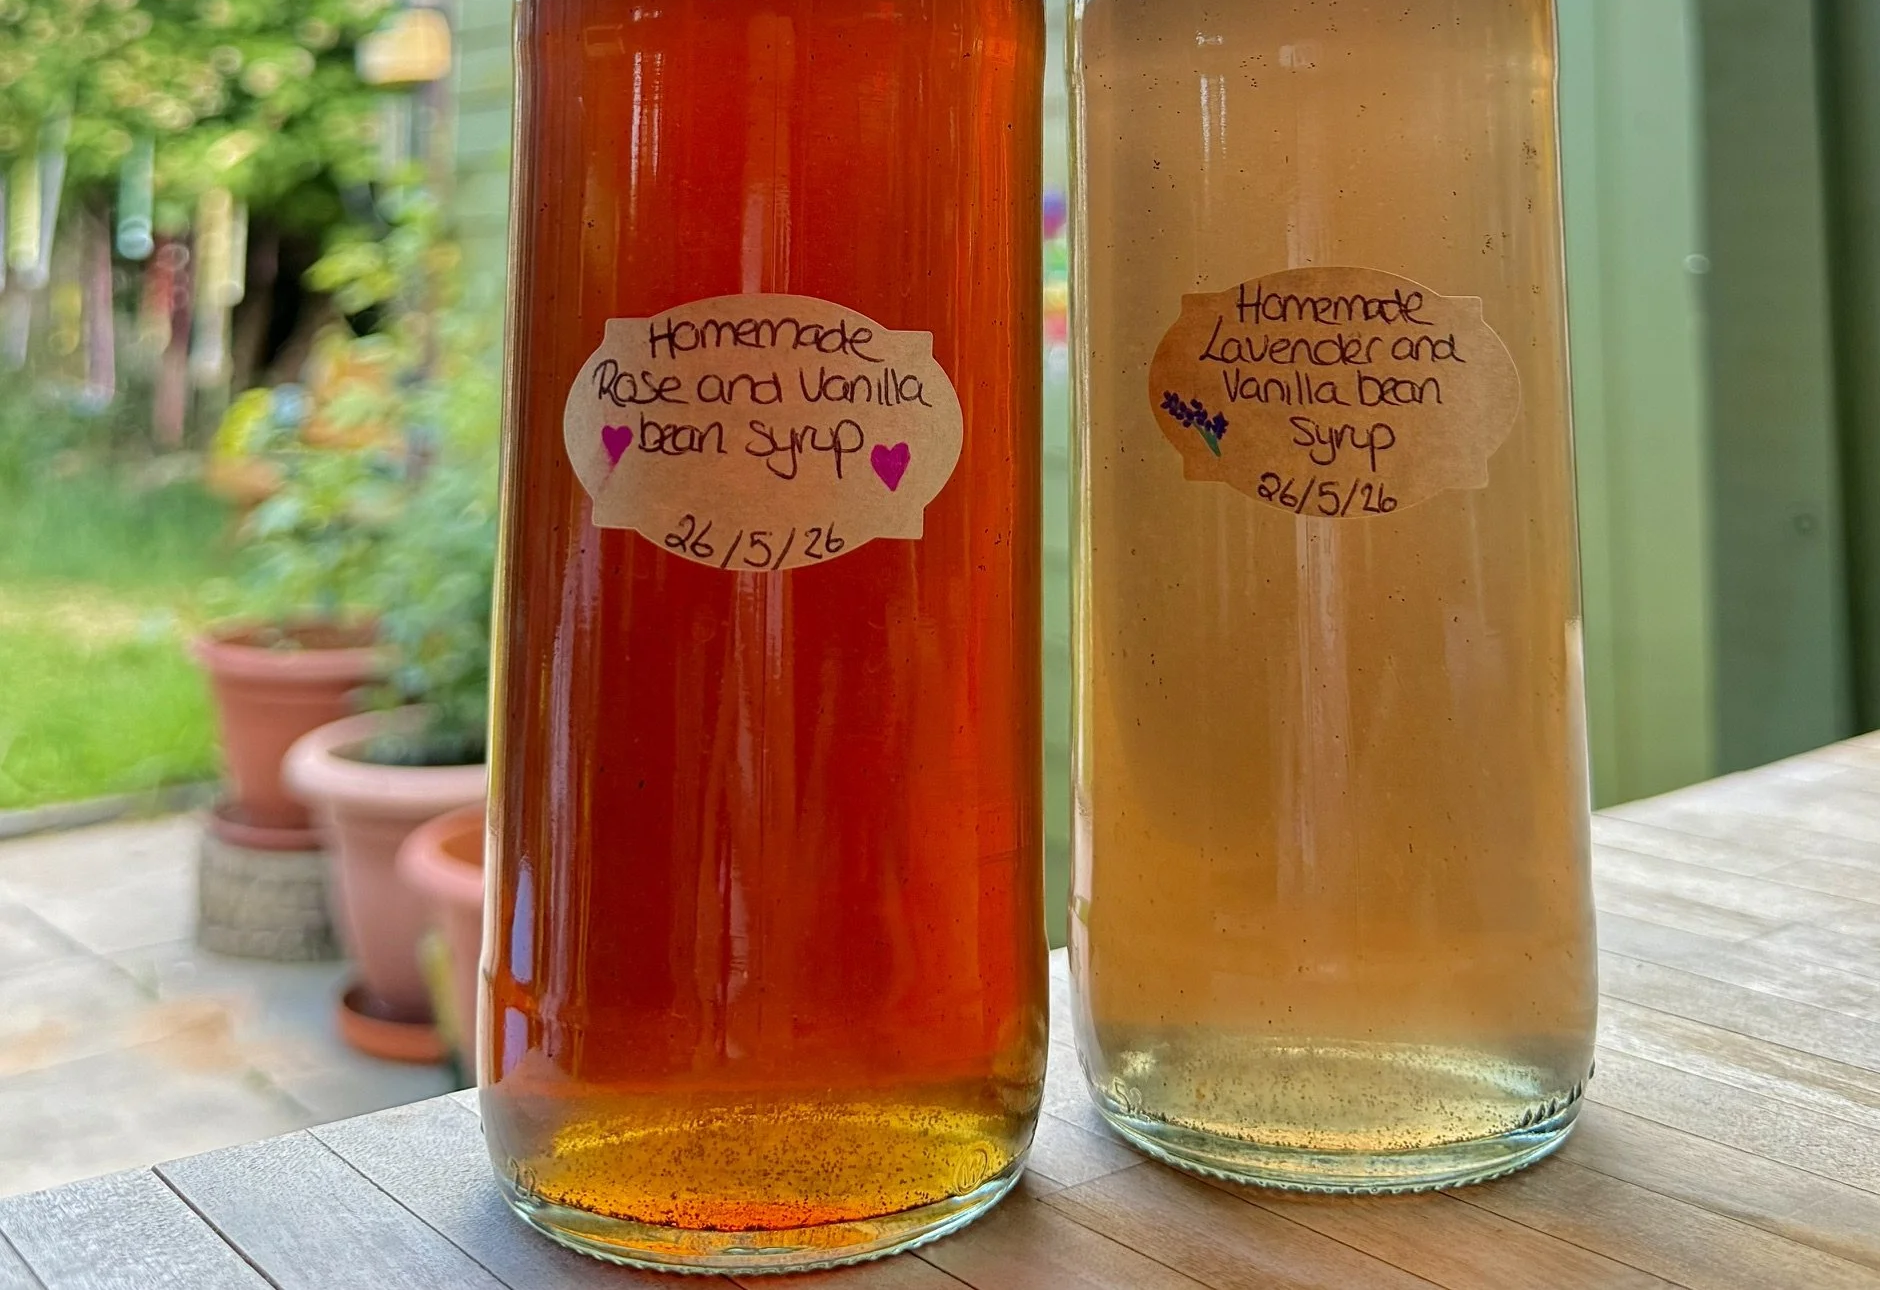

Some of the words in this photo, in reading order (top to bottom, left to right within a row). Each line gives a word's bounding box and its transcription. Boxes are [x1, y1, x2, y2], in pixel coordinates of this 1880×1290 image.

[1235, 283, 1434, 326] Homemade
[648, 317, 885, 363] Homemade
[1199, 315, 1381, 366] Lavender
[1391, 333, 1467, 363] and
[593, 358, 690, 407] Rose
[697, 370, 783, 405] and
[1356, 369, 1442, 406] bean
[637, 411, 728, 455] bean
[1256, 471, 1398, 517] 26/5/26
[664, 513, 846, 571] 26/5/26
